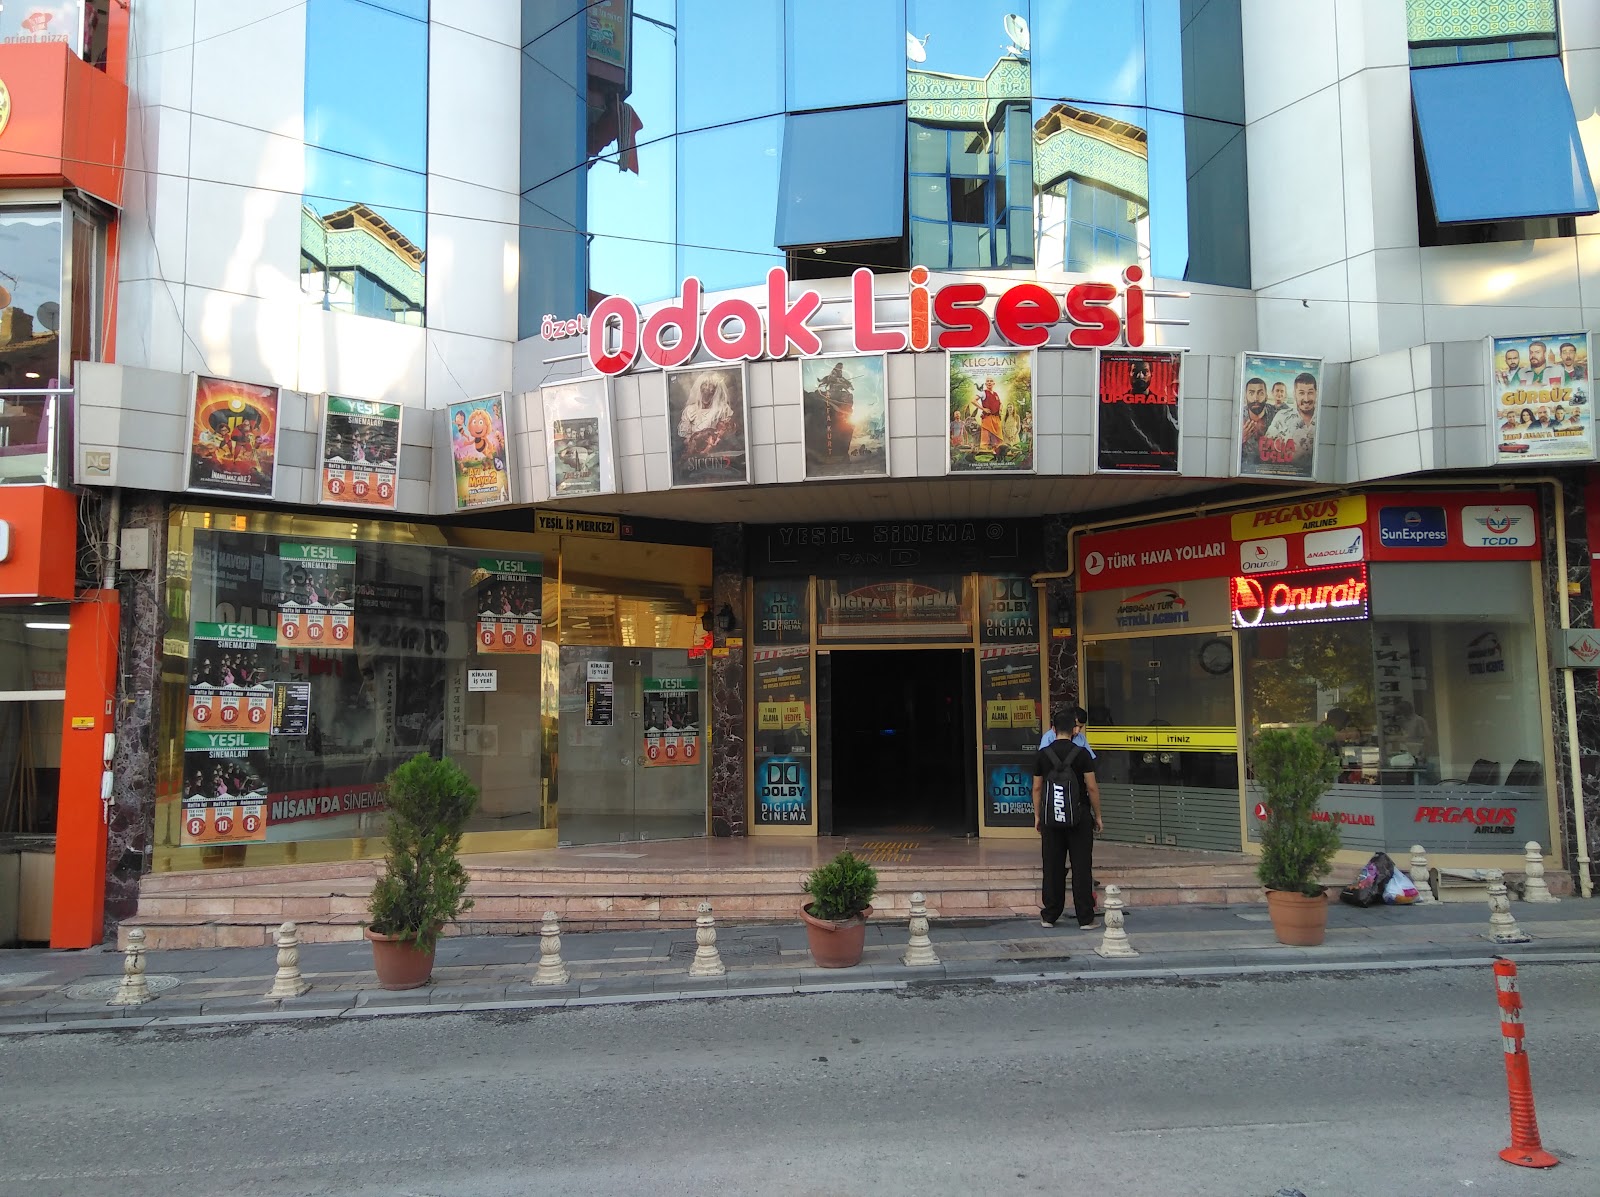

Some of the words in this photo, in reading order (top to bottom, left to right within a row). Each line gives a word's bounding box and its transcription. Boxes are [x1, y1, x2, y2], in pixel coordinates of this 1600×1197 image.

[540, 313, 587, 341] Özel
[588, 266, 823, 376] Odak
[851, 264, 1145, 352] Lisesi
[1101, 394, 1176, 404] UPGRADE
[1502, 388, 1573, 406] GÜRBÜZ
[332, 481, 340, 494] 8
[356, 484, 364, 494] 10
[381, 485, 388, 497] 8
[1253, 500, 1339, 528] PEGASUS
[539, 516, 563, 531] YEŞİL
[566, 516, 573, 532] İŞ
[576, 520, 615, 534] MERKEZİ
[1302, 517, 1338, 530] AIRLINES
[1382, 528, 1446, 542] SunExpress
[1482, 537, 1518, 546] TCDD
[1107, 553, 1136, 570] TÜRK
[1141, 547, 1172, 565] HAVA
[1176, 542, 1225, 561] YOLLARI
[1306, 547, 1359, 558] ANADOLUJET
[1242, 558, 1280, 570] Onurair
[1269, 578, 1366, 614] Onurair
[987, 601, 1032, 612] DOLBY
[762, 620, 777, 630] 3D
[986, 618, 1033, 628] DIGITAL
[287, 625, 293, 637] 8
[310, 627, 319, 637] 10
[336, 627, 343, 638] 8
[986, 628, 1033, 636] CINEMA
[504, 635, 512, 644] 10
[197, 708, 205, 721] 8
[224, 709, 233, 720] 10
[252, 709, 260, 722] 8
[1167, 735, 1190, 743] İTİNİZ
[667, 748, 674, 756] 10
[762, 786, 805, 796] DOLBY
[272, 795, 341, 820] NİSAN'DA
[761, 802, 806, 812] DIGITAL
[993, 803, 1010, 813] 3D
[1054, 784, 1066, 823] SPORT
[761, 812, 806, 821] CINEMA
[1309, 811, 1331, 822] AVA
[1414, 806, 1517, 826] PEGASUS
[192, 820, 199, 834] 8
[218, 820, 227, 831] 10
[247, 818, 254, 830] 8
[1474, 826, 1515, 834] AIRLINES
